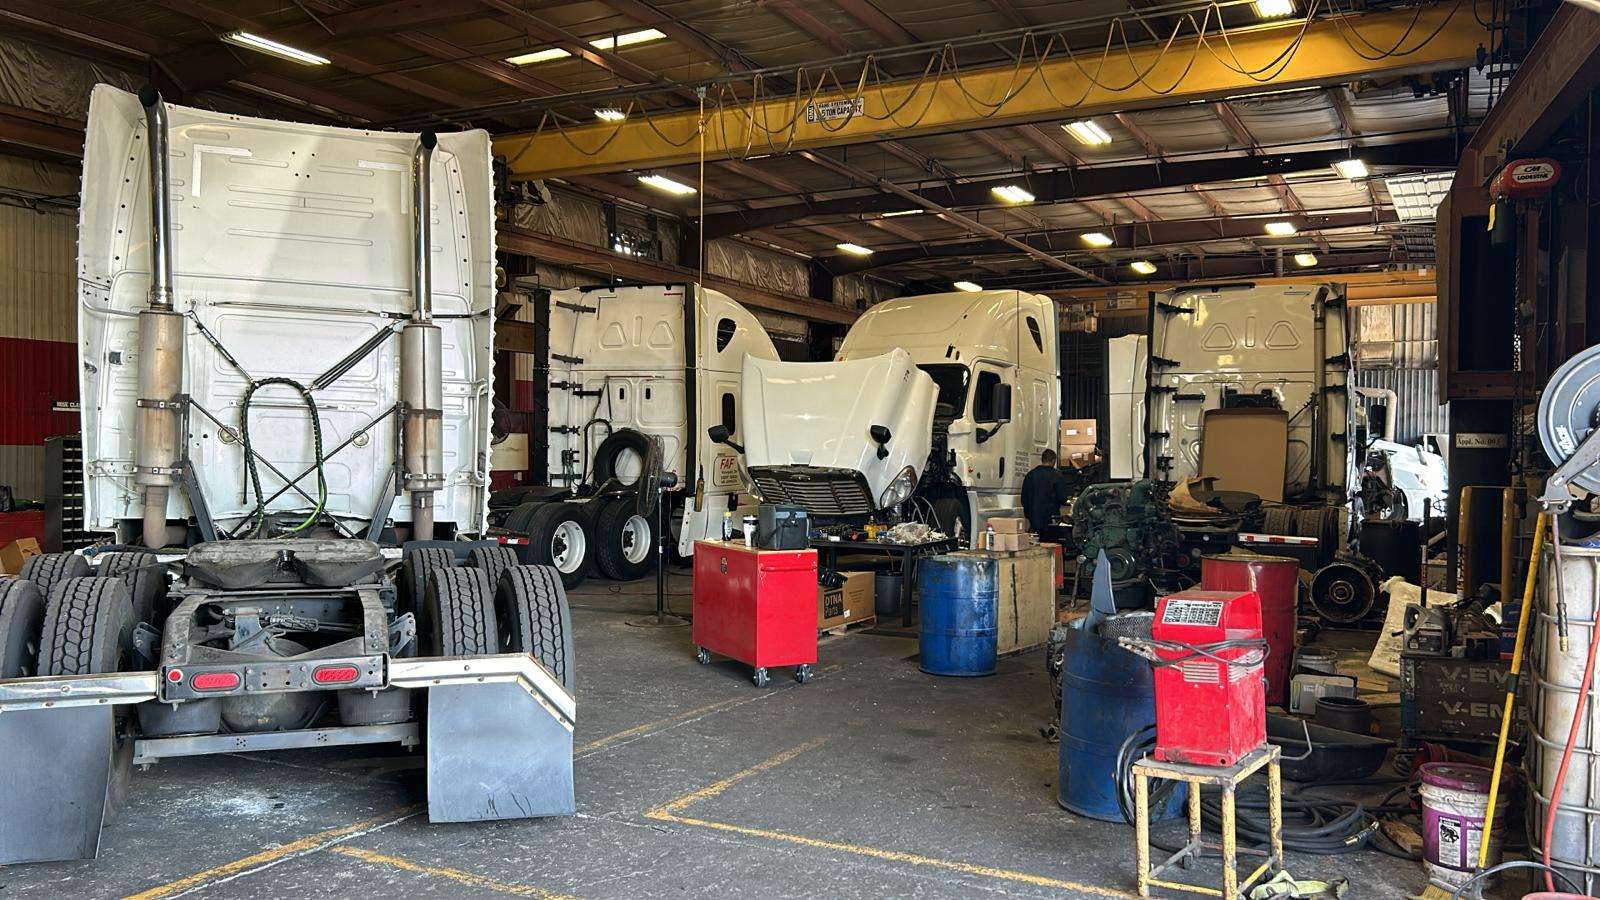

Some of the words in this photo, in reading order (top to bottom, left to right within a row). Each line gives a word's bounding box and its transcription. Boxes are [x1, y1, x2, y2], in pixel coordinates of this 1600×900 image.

[826, 108, 837, 116] TON
[1524, 165, 1542, 173] CM
[719, 457, 735, 470] FAF
[825, 593, 842, 606] DTNA
